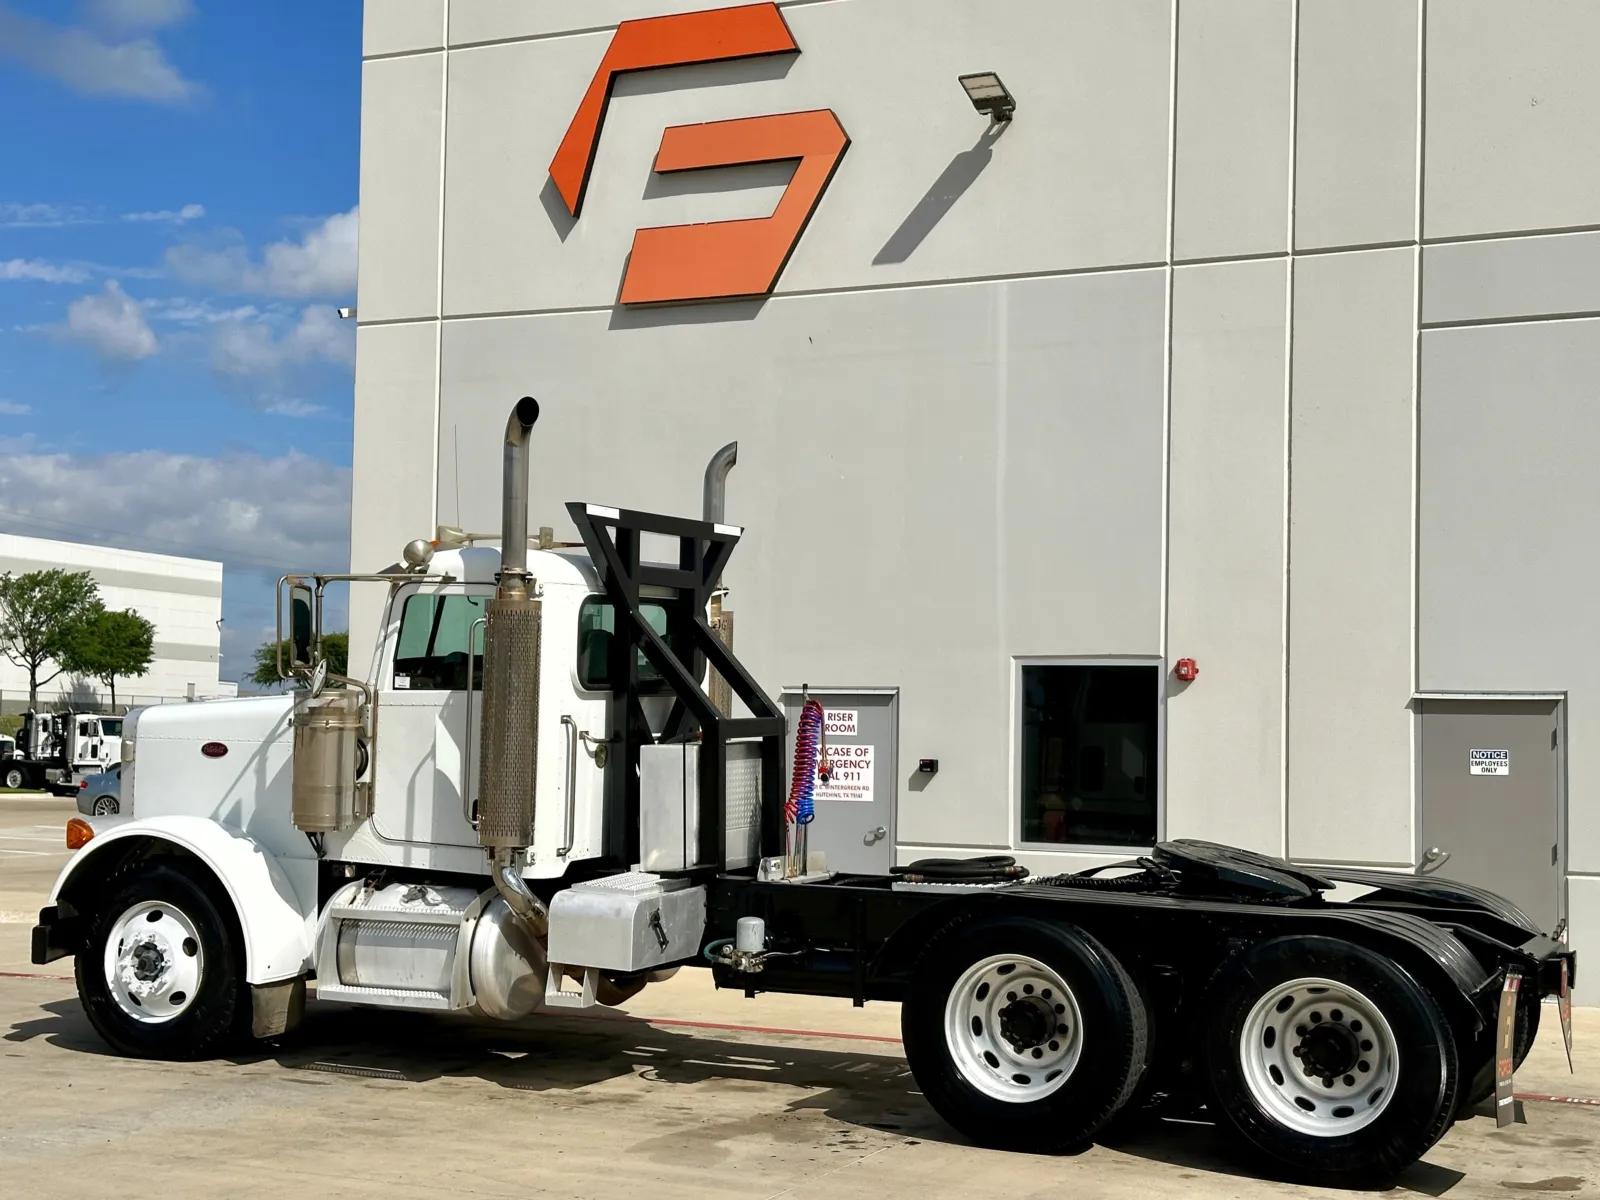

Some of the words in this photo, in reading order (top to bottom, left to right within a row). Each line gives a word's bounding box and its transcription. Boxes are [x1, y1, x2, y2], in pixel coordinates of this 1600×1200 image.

[827, 712, 853, 721] RISER
[825, 723, 856, 732] ROOM
[826, 747, 852, 757] CASE
[855, 748, 869, 757] OF
[1472, 751, 1506, 759] NOTICE
[843, 772, 861, 781] 911
